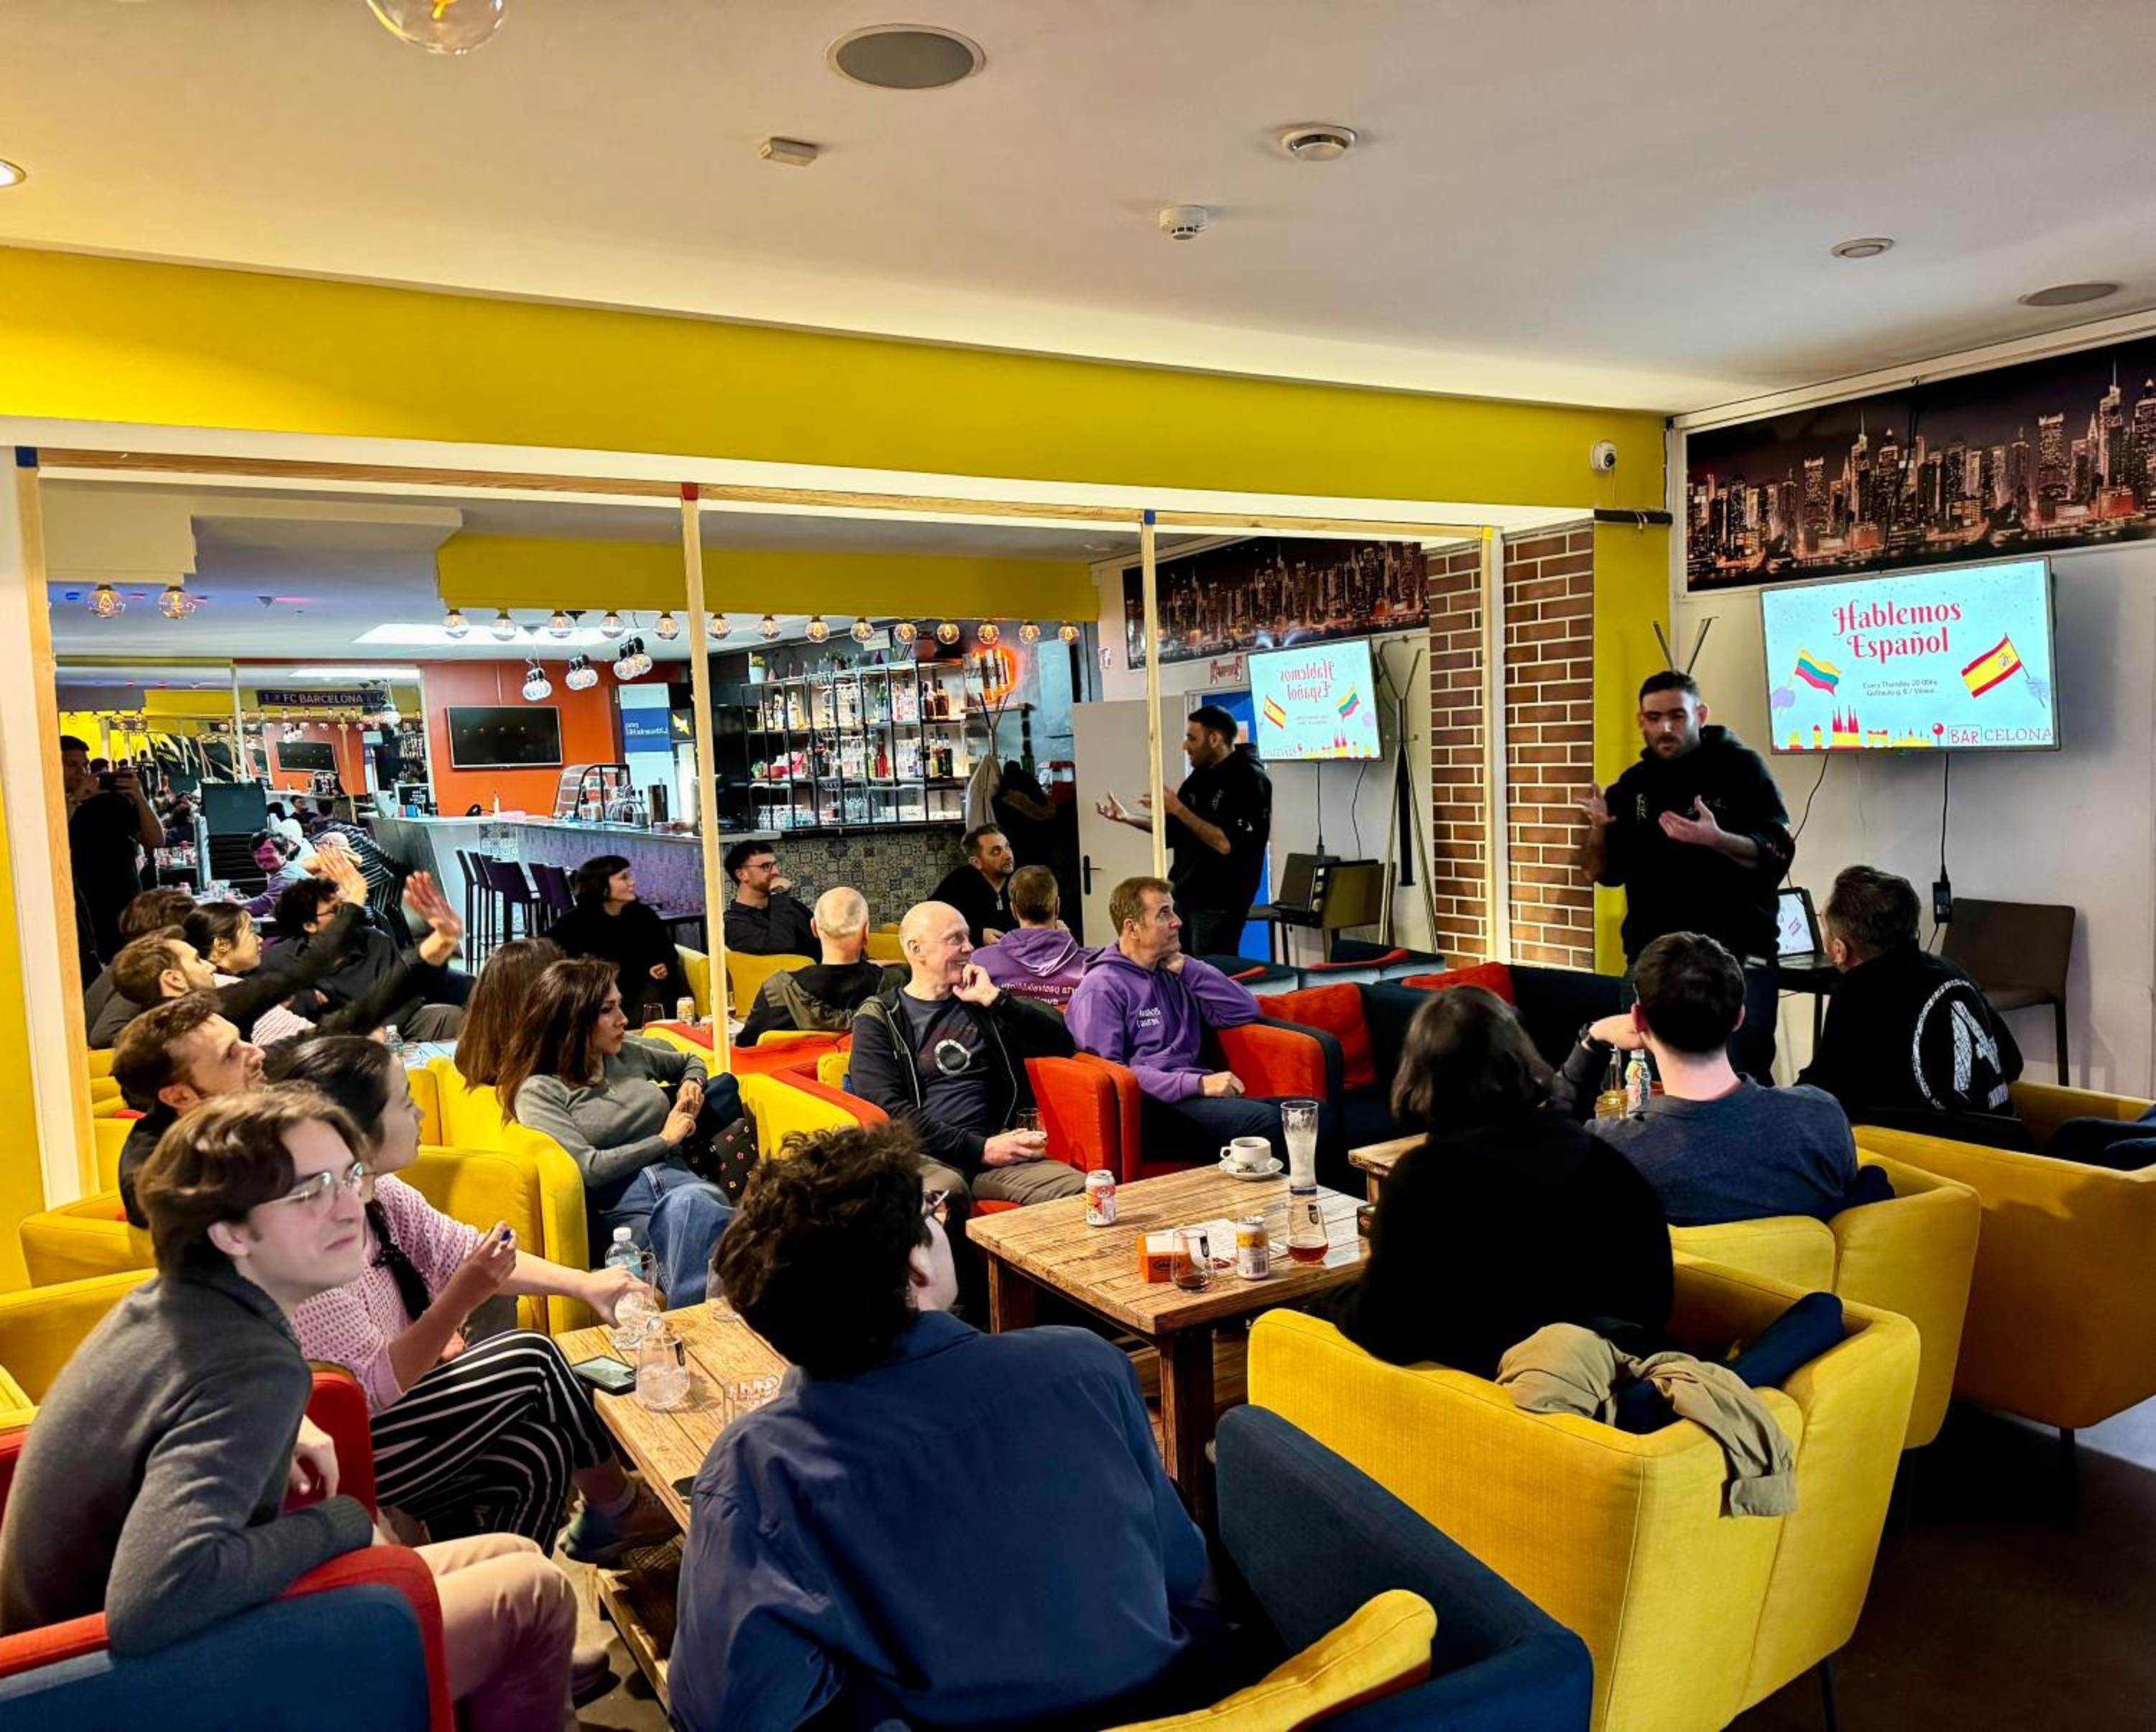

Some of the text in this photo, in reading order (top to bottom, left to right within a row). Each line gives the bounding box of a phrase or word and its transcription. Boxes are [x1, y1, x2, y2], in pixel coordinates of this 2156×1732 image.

[1833, 599, 1961, 636] Hablemos
[1846, 626, 1948, 664] Español
[1881, 680, 1909, 688] Thursday
[283, 694, 363, 704] FC BARCELONA
